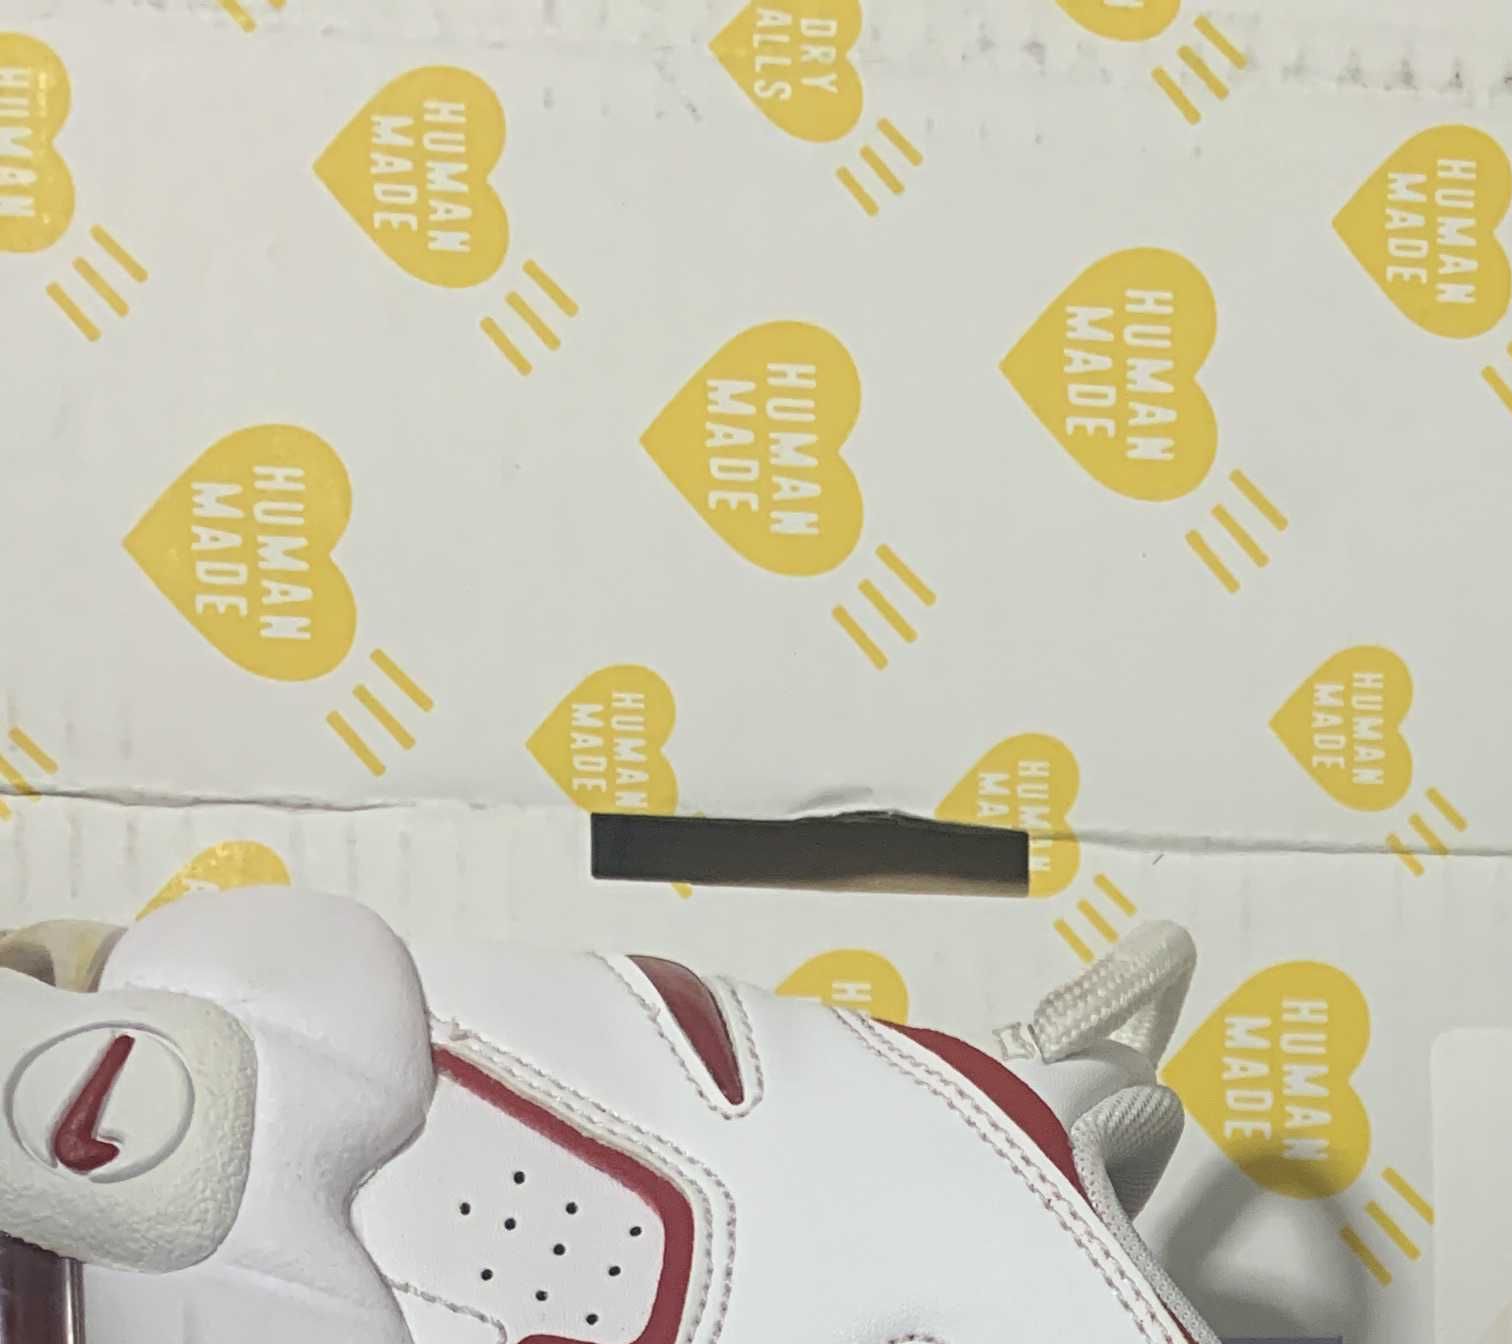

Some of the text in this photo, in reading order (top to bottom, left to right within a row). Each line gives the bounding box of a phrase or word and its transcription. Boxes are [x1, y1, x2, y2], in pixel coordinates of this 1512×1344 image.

[752, 6, 793, 100] ALLS
[799, 17, 838, 92] DRY
[370, 114, 418, 230] MADE
[421, 100, 472, 253] HUMAN
[1386, 171, 1430, 281] MADE
[1434, 158, 1479, 304] HUMAN
[1064, 305, 1117, 436] MADE
[1123, 288, 1177, 461] HUMAN
[706, 378, 761, 510] MADE
[766, 362, 821, 535] HUMAN
[191, 481, 248, 615] MADE
[252, 465, 313, 640] HUMAN
[572, 702, 609, 789] MADE
[611, 691, 649, 809] HUMAN
[1311, 681, 1346, 767] MADE
[1352, 671, 1385, 784] HUMAN
[1222, 1015, 1273, 1141] MADE
[1279, 999, 1331, 1163] HUMAN
